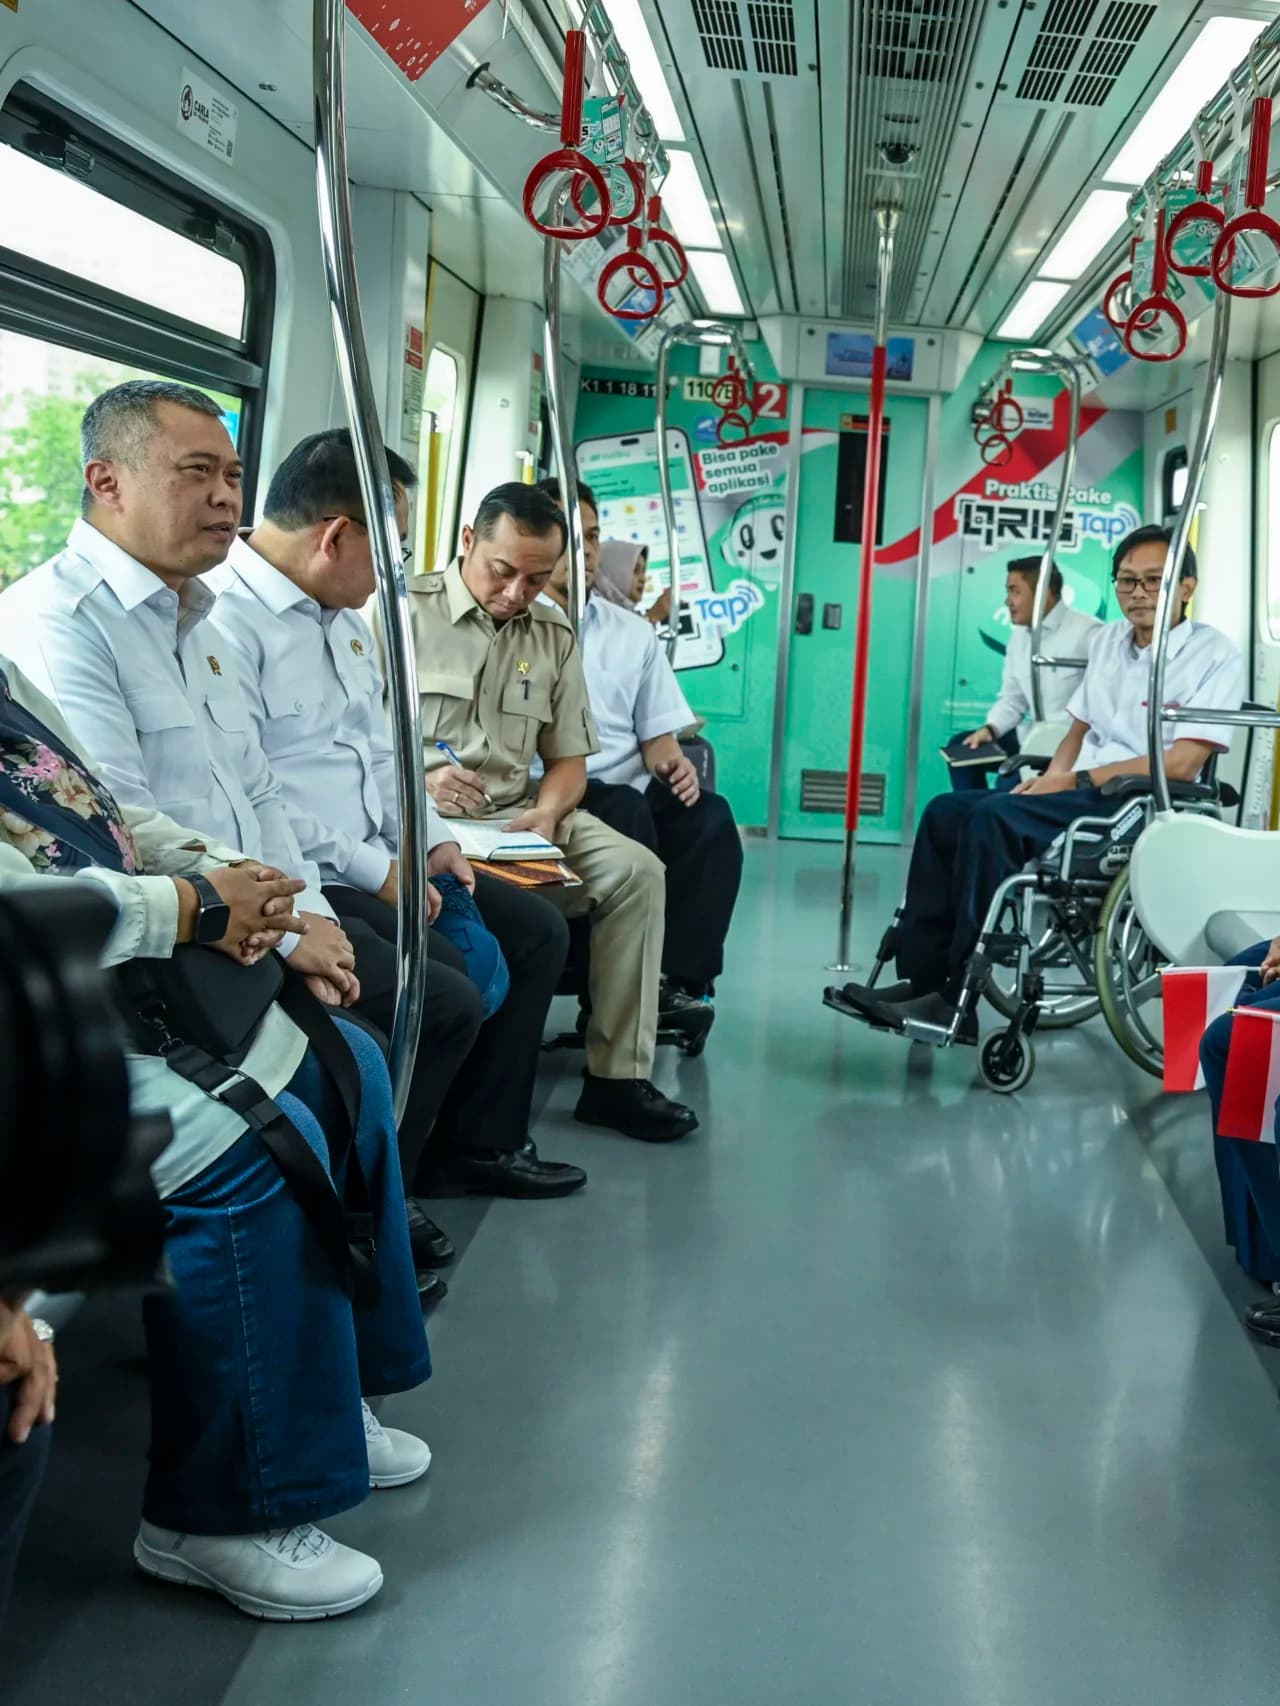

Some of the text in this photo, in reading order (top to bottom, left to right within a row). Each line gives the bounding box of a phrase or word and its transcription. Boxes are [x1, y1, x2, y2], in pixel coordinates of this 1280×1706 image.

[620, 382, 638, 397] 18
[758, 383, 781, 418] 2
[701, 444, 777, 466] Bisa pake
[704, 463, 758, 479] semua
[708, 474, 770, 494] aplikasi
[985, 479, 1058, 500] Praktis
[963, 503, 1126, 546] QRIS Tap
[694, 596, 749, 626] Tap
